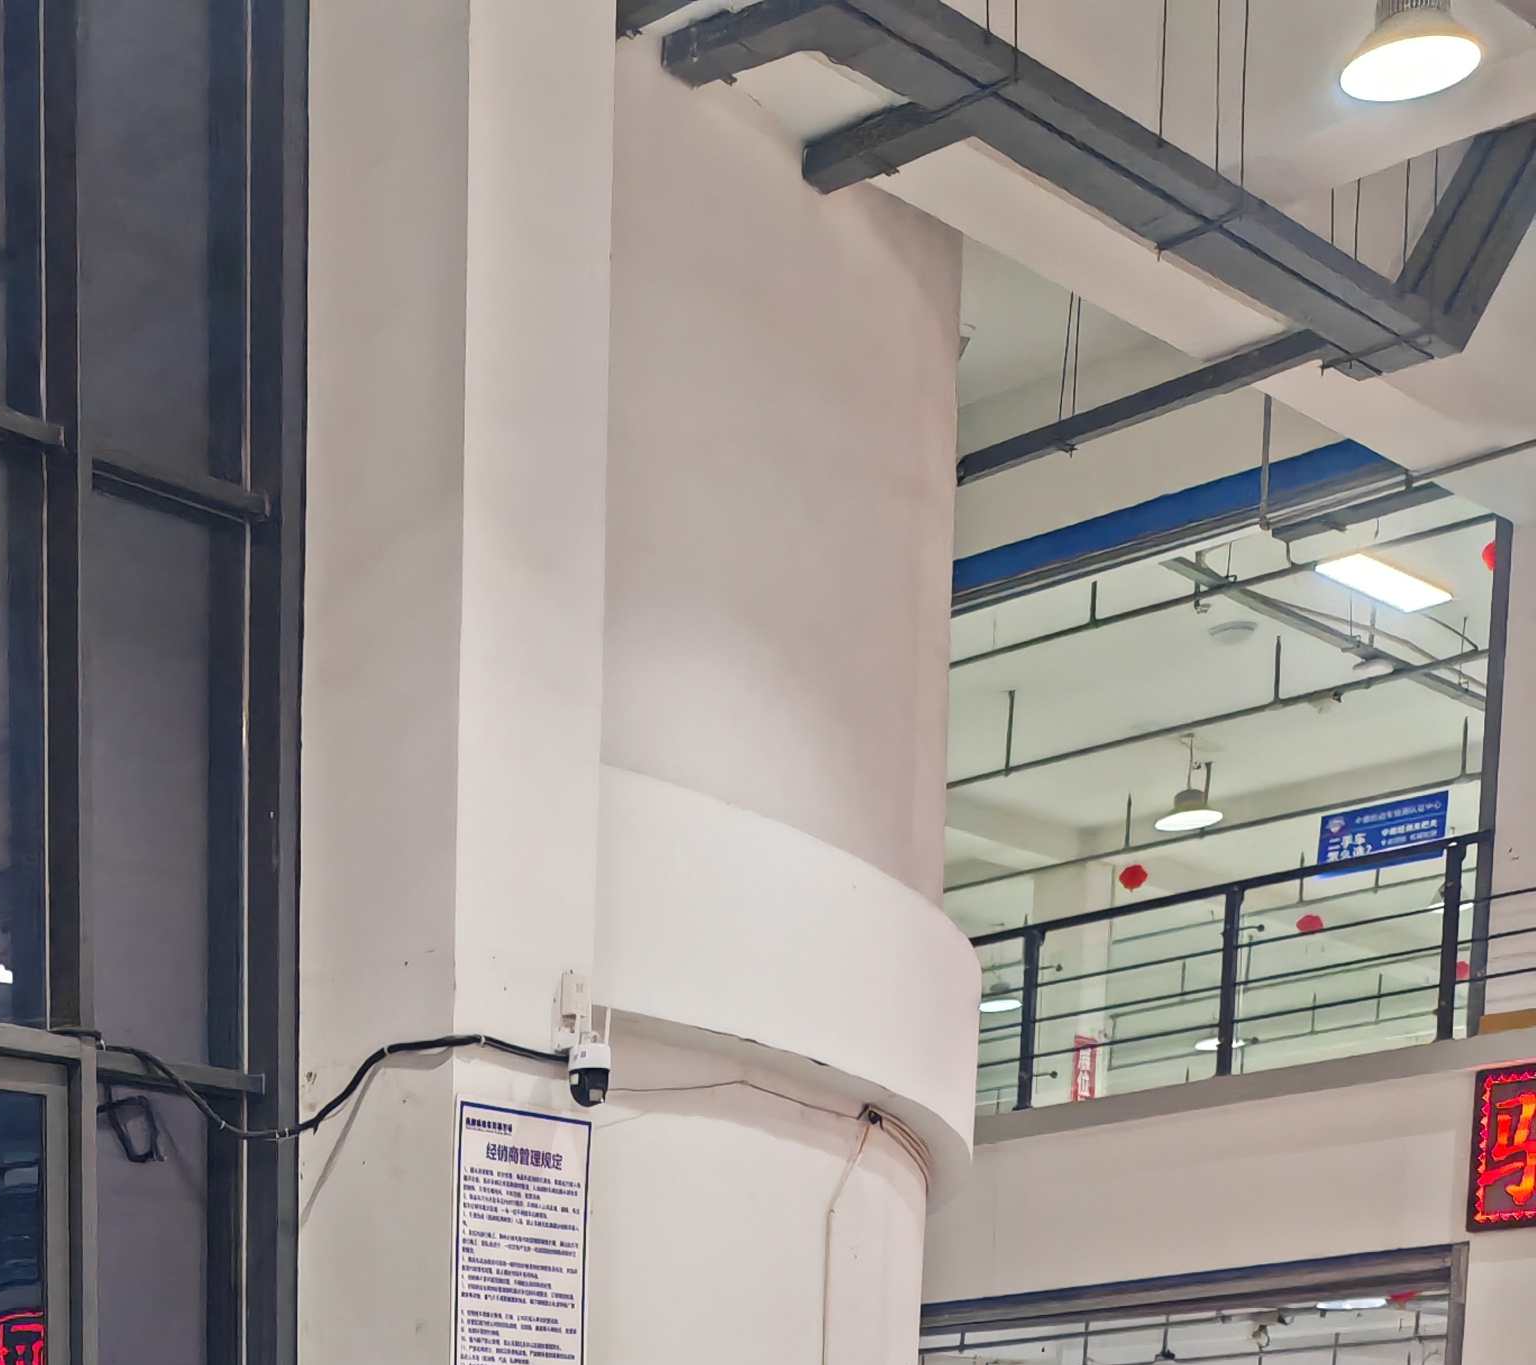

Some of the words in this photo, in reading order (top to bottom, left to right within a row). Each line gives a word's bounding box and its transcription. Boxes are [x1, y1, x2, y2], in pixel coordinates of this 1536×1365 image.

[1328, 833, 1366, 850] 二手车
[486, 1142, 563, 1171] 经销商管理规定
